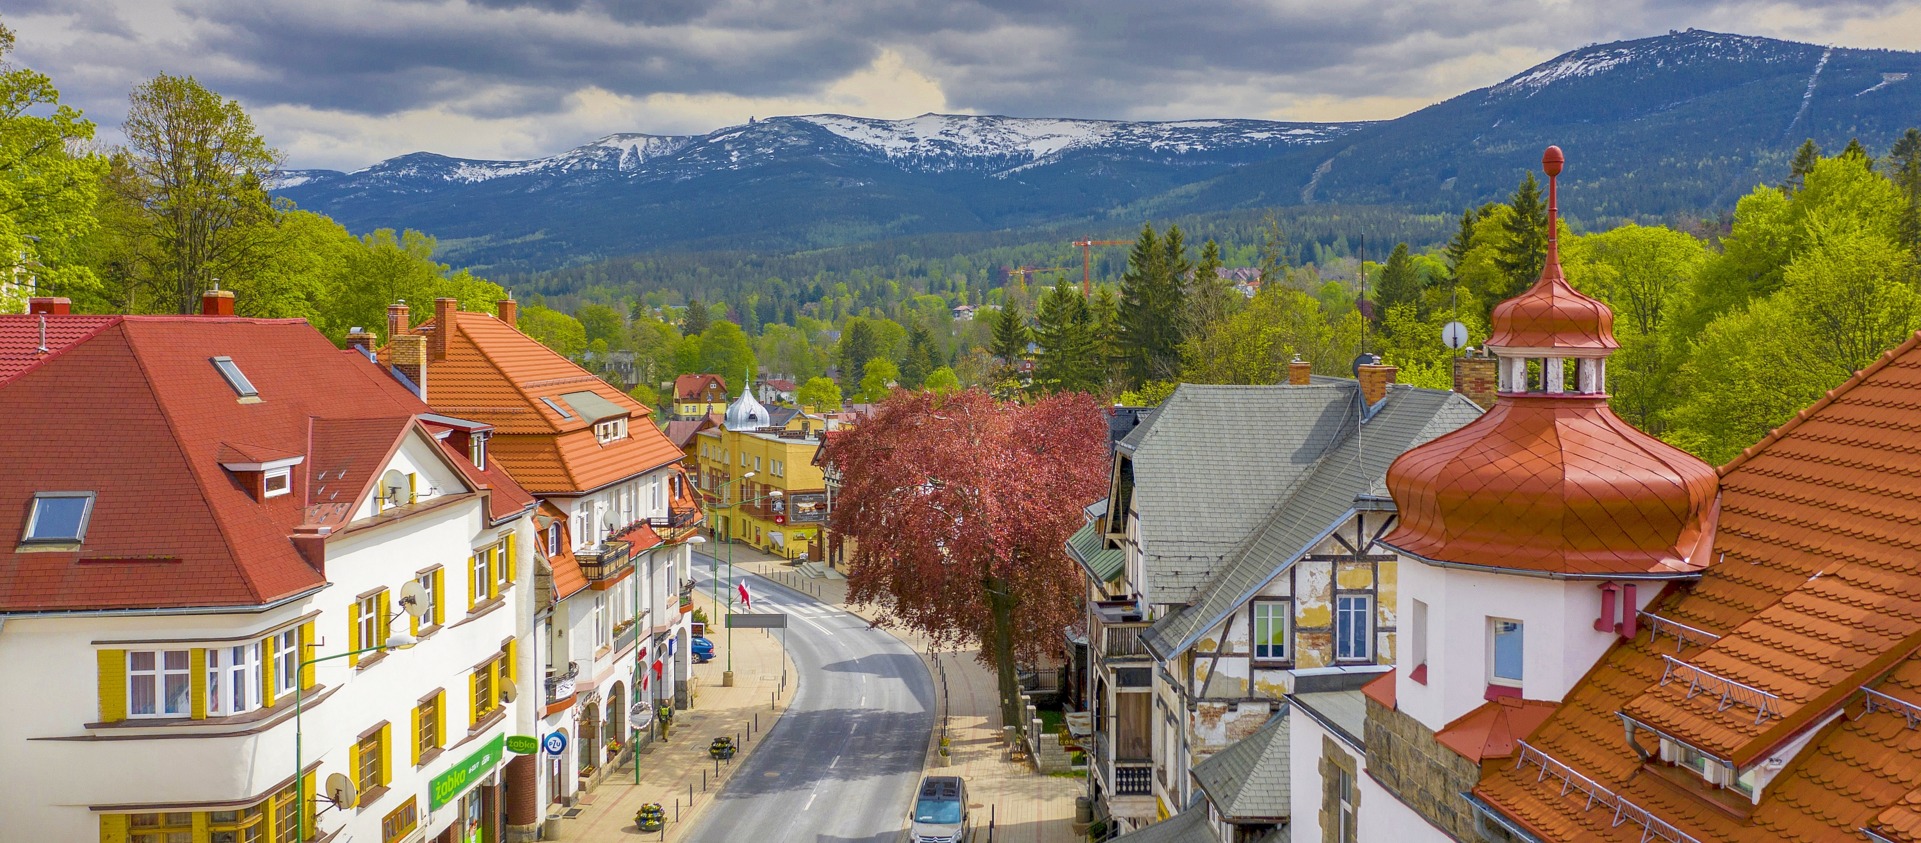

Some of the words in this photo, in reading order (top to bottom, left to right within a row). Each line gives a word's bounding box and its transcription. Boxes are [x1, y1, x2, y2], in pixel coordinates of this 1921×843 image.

[509, 739, 536, 749] żabka
[548, 740, 560, 749] PZU
[435, 769, 466, 801] żabka
